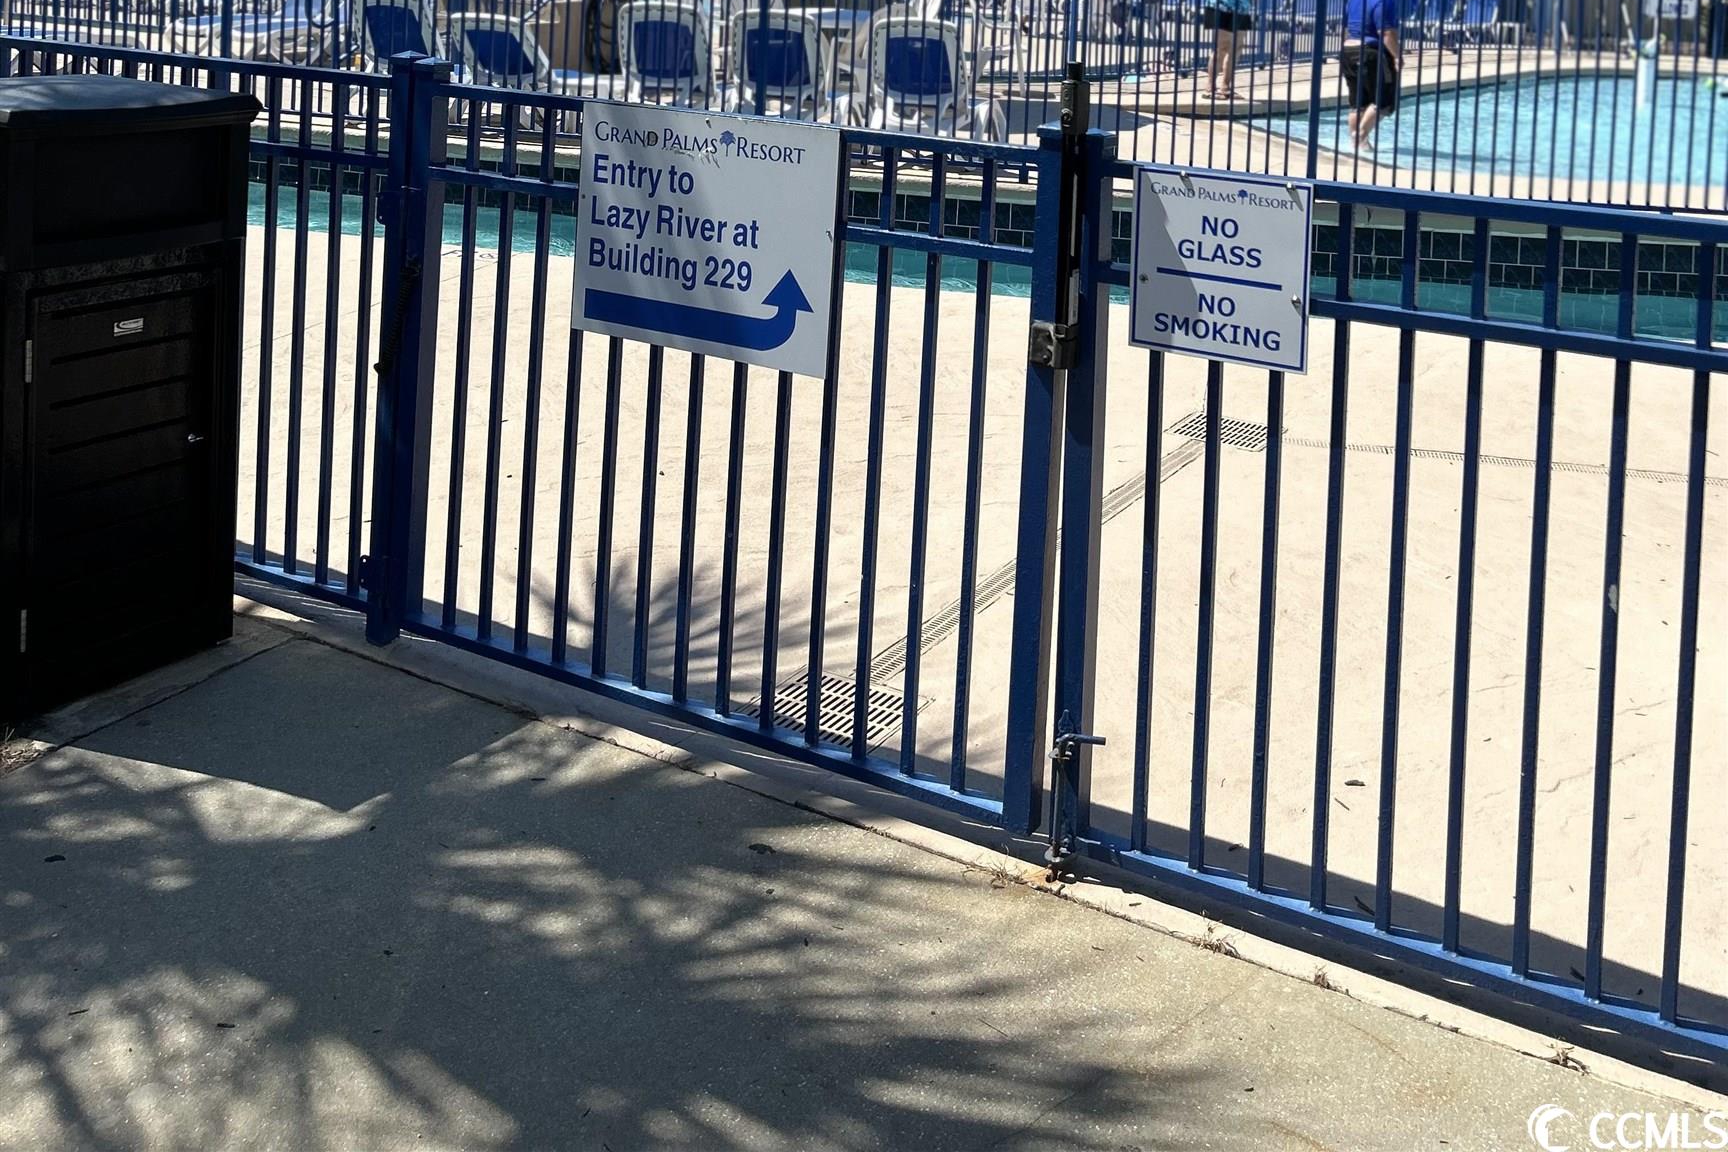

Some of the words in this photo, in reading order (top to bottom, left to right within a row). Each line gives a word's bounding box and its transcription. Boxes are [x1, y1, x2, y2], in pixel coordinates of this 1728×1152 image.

[595, 121, 659, 147] GRAND
[663, 128, 718, 155] PALMS
[737, 137, 806, 164] RESORT
[593, 154, 662, 198] Entry
[669, 165, 694, 195] to
[1151, 182, 1195, 198] GRAND
[1198, 187, 1237, 204] PALMS
[1249, 193, 1297, 210] RESORT
[591, 195, 650, 239] Lazy
[657, 204, 728, 244] River
[733, 220, 759, 249] at
[1201, 216, 1239, 239] NO
[589, 237, 697, 291] Building
[704, 256, 752, 292] 229
[1178, 239, 1262, 268] GLASS
[1198, 293, 1236, 317] NO
[1154, 312, 1281, 352] SMOKING
